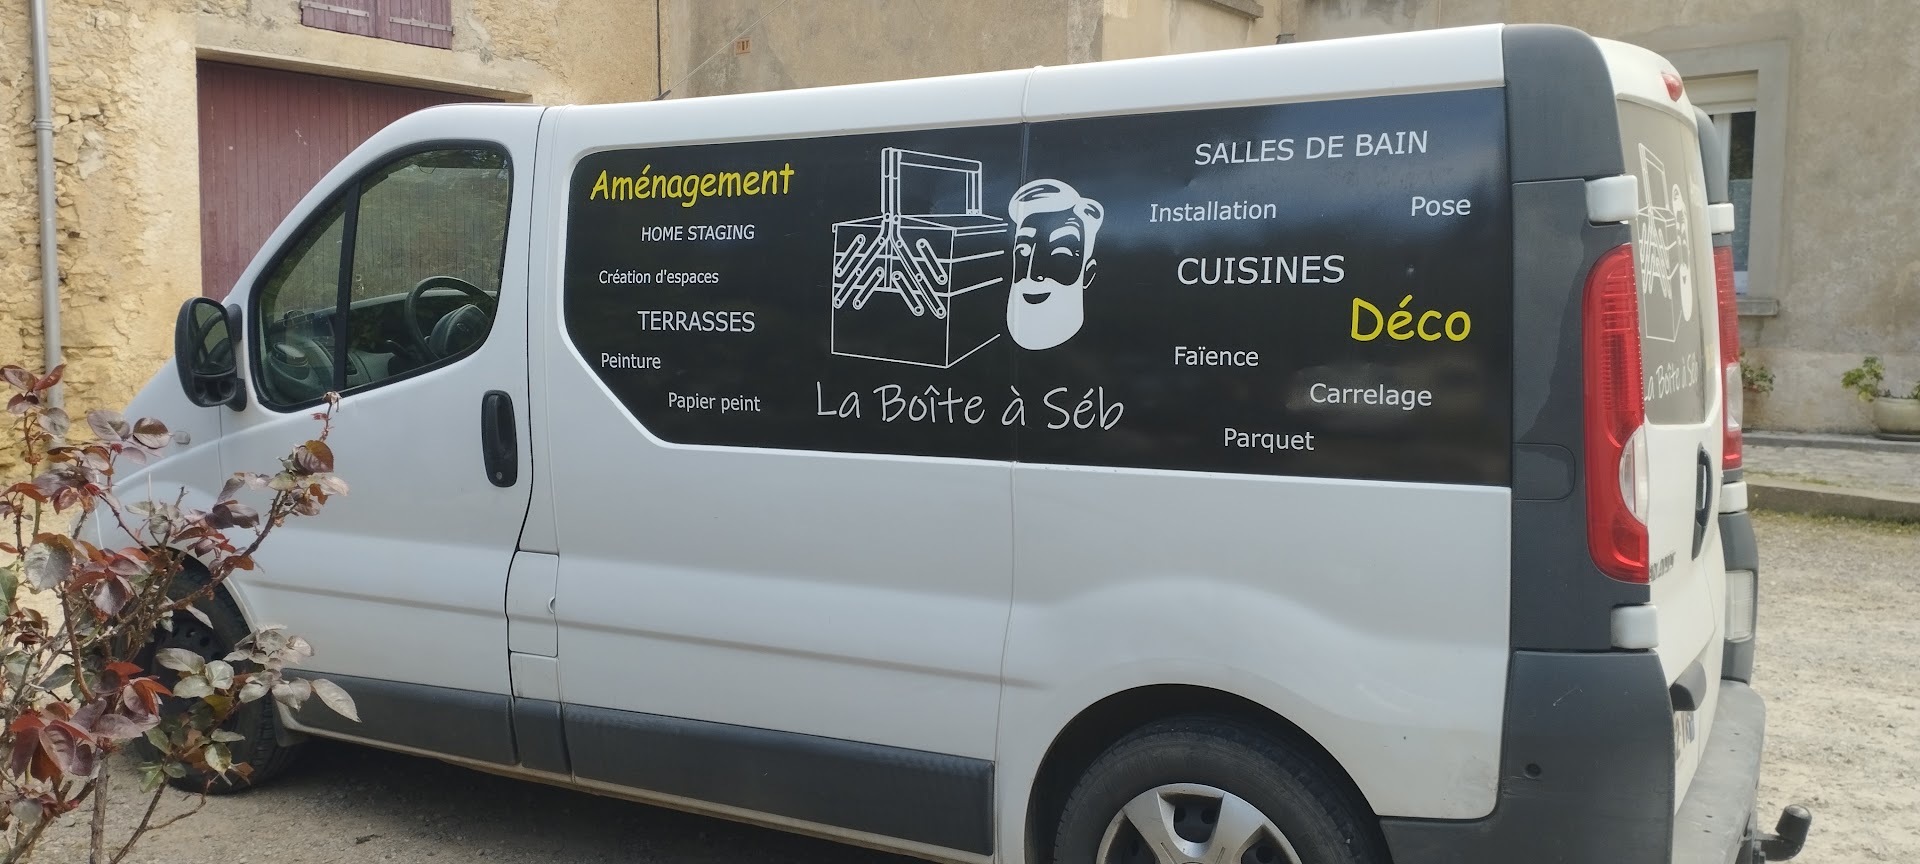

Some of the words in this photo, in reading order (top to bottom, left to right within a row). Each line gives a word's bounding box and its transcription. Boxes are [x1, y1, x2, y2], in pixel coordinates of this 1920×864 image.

[1194, 138, 1295, 166] SALLES
[1306, 135, 1345, 160] DE
[1355, 130, 1428, 157] BAIN
[589, 162, 795, 208] Aménagement
[1149, 200, 1277, 223] Installation
[1411, 196, 1471, 217] Pose
[641, 225, 684, 242] HOME
[687, 223, 756, 241] STAGING
[598, 268, 652, 285] Création
[656, 268, 720, 287] d'espaces
[1177, 254, 1345, 285] CUISINES
[636, 310, 756, 333] TERRASSES
[1350, 294, 1472, 342] Déco
[601, 352, 662, 370] Peinture
[1174, 345, 1259, 367] Faïence
[1656, 362, 1681, 399] Boîte
[668, 391, 716, 413] Papier
[721, 394, 761, 414] peint
[816, 380, 861, 419] La
[872, 383, 986, 425] Boîte
[1001, 384, 1026, 427] à
[1043, 385, 1124, 431] Séb
[1309, 382, 1433, 411] Carrelage
[1224, 427, 1315, 454] Parquet
